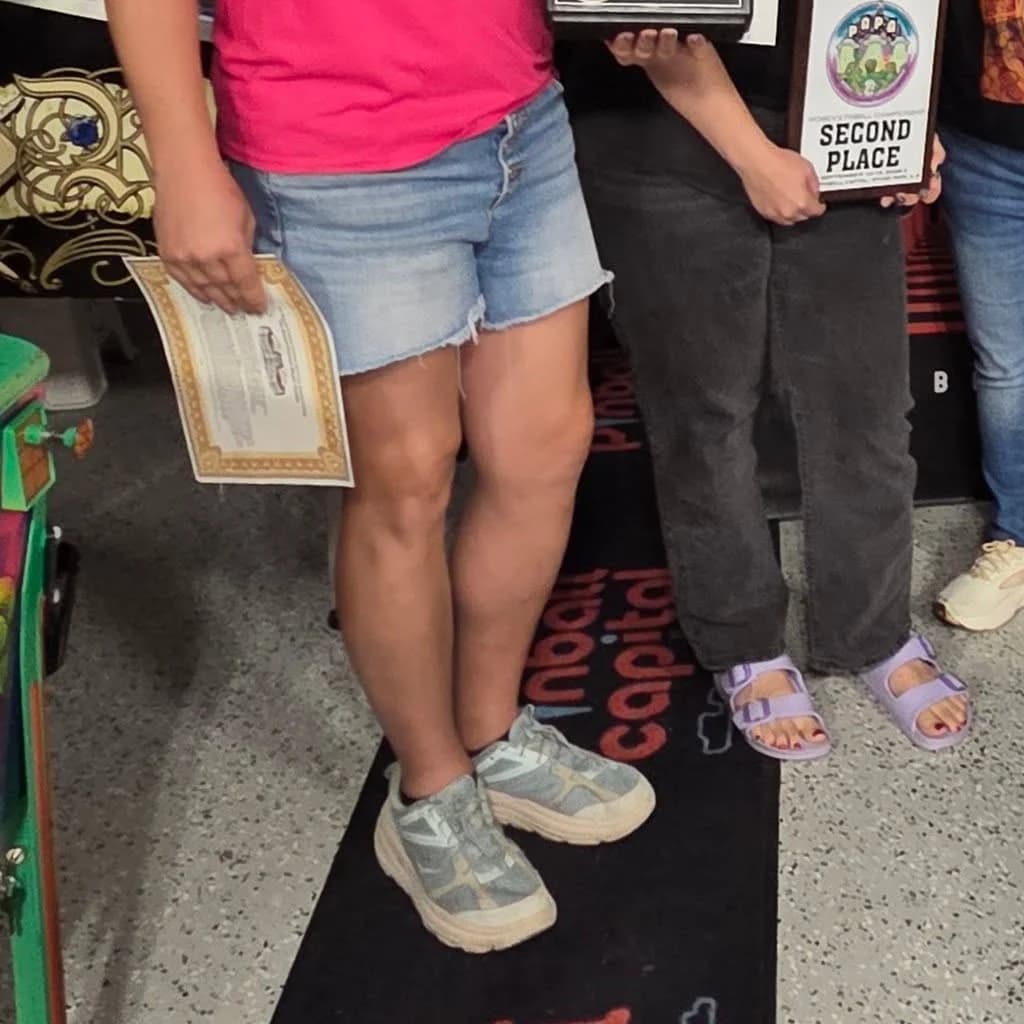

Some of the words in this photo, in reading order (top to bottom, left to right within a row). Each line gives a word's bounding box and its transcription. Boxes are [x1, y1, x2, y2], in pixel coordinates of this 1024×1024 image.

[849, 15, 897, 37] PAPA
[819, 119, 911, 146] SECOND
[826, 145, 901, 173] PLACE
